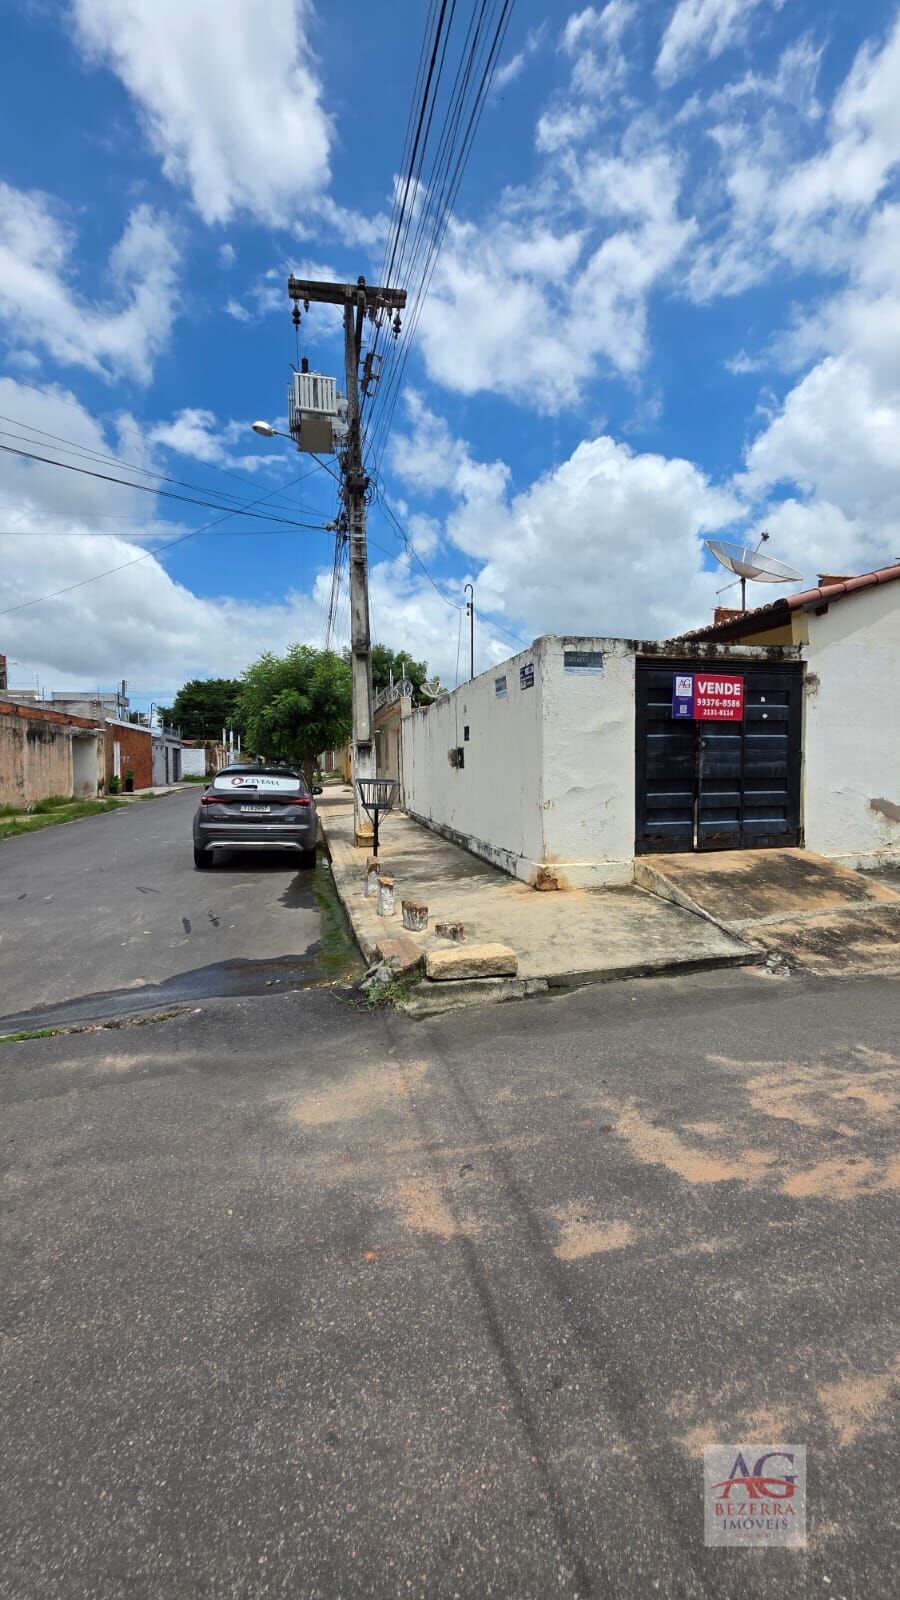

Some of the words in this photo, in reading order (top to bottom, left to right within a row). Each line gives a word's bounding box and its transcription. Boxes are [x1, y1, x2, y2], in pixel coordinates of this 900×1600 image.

[697, 681, 741, 696] VENDE
[696, 698, 741, 708] 99376-8586
[245, 778, 280, 786] CEVEMA
